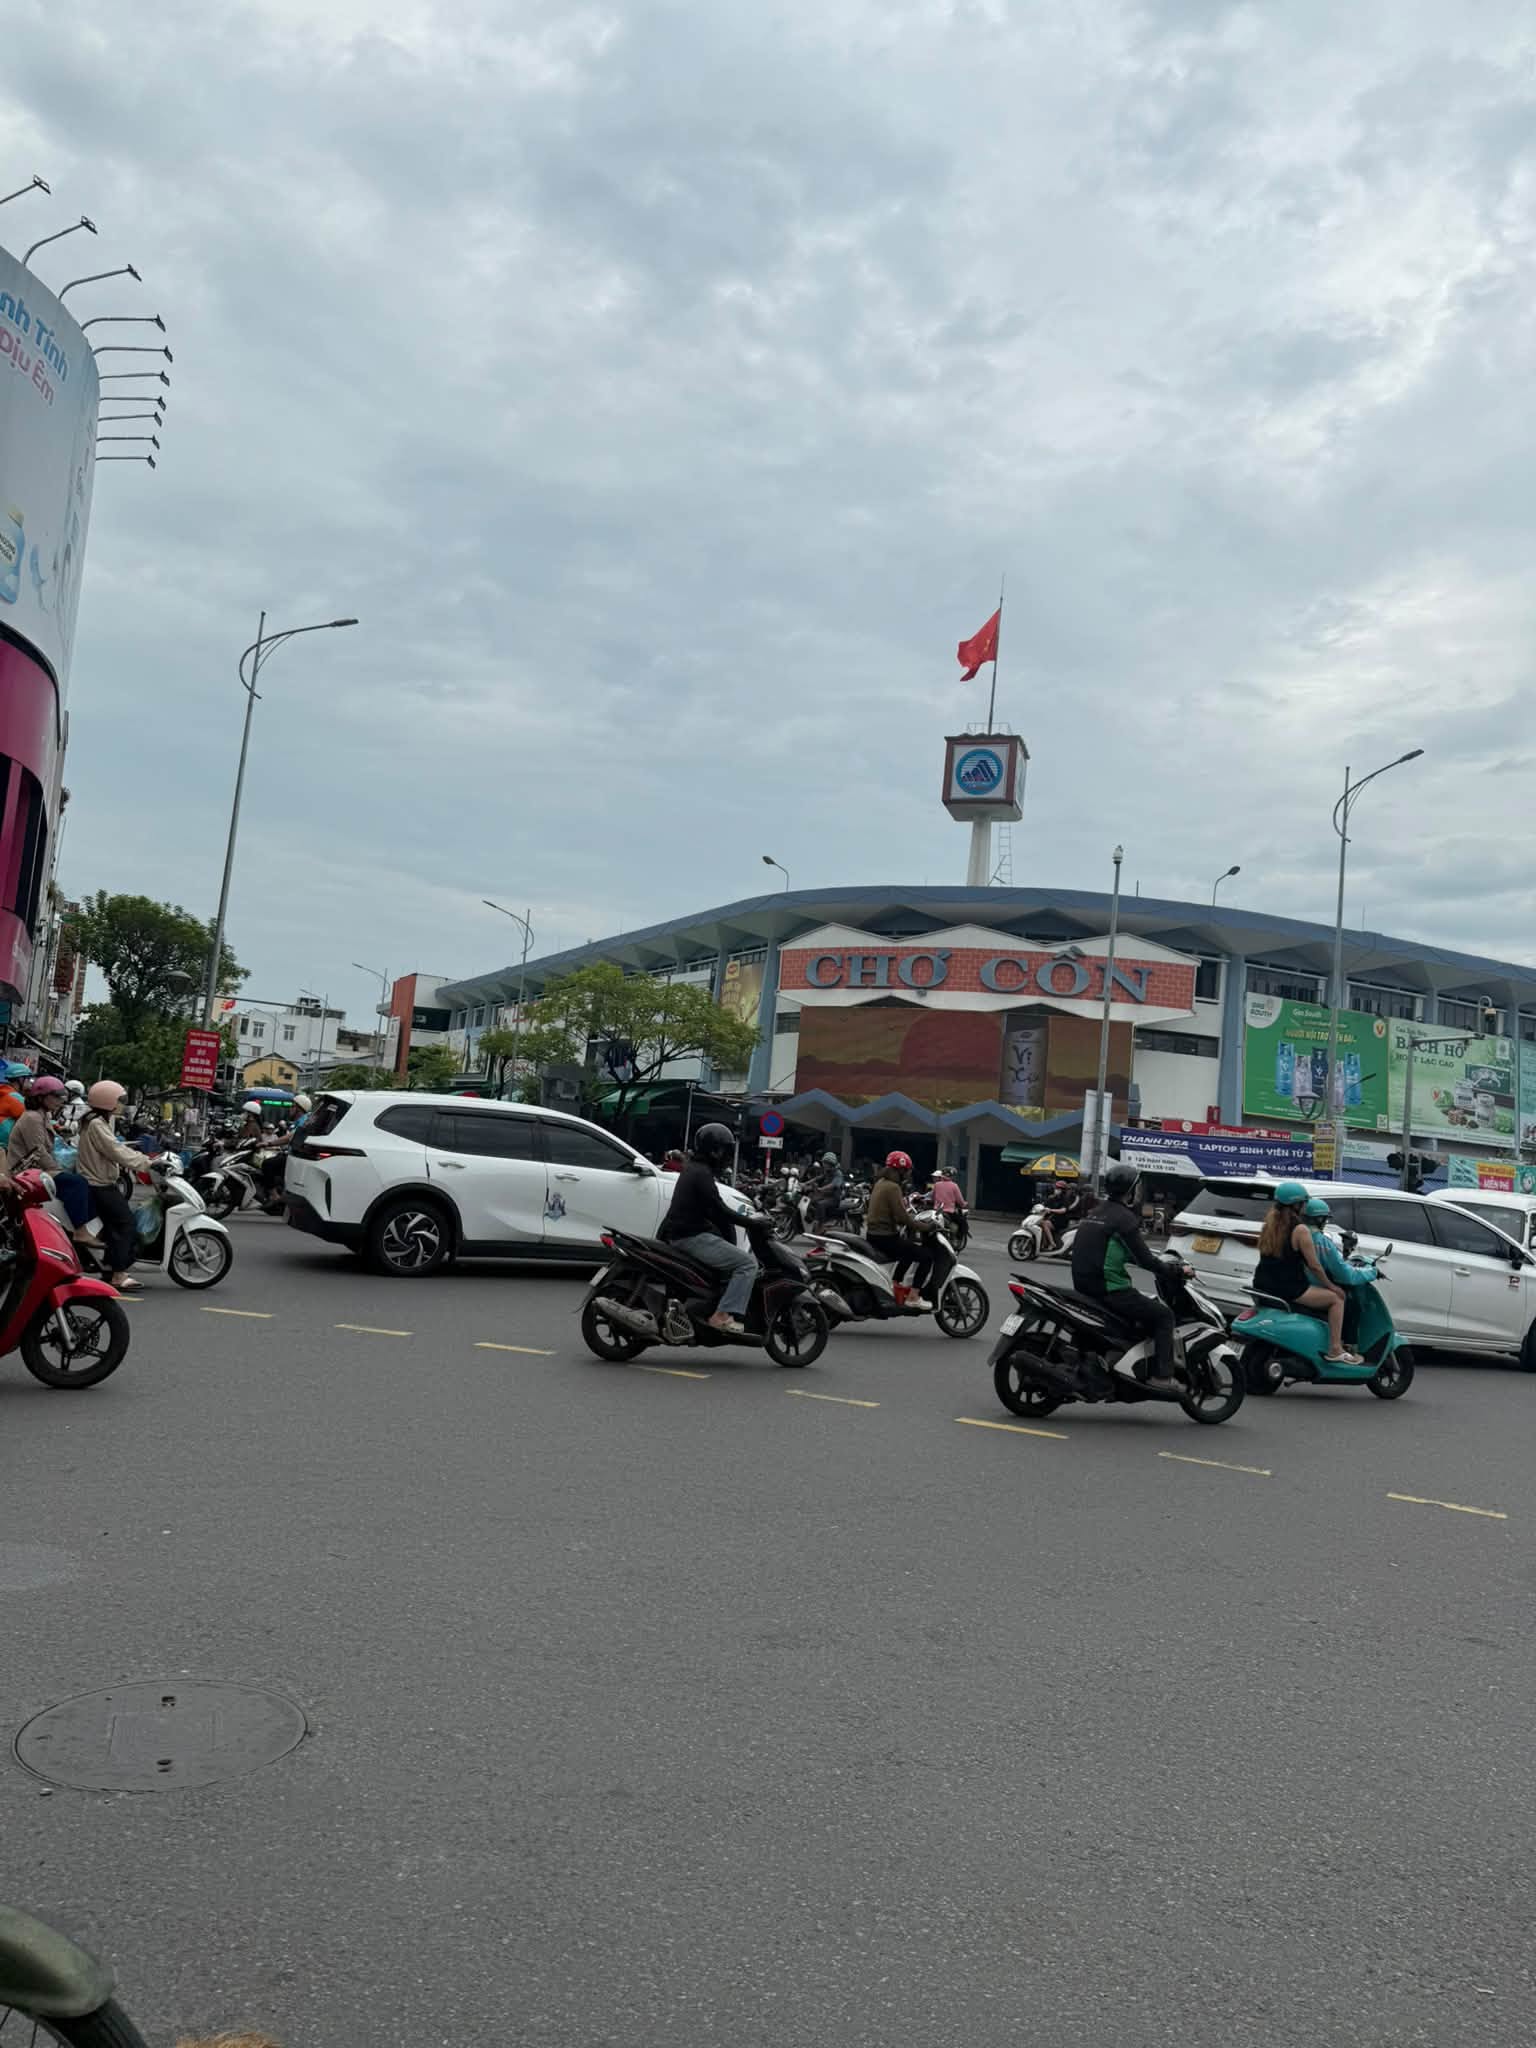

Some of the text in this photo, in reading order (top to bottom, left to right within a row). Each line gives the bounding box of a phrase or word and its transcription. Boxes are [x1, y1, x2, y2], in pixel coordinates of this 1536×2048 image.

[0, 326, 55, 407] Dịu Êm
[35, 317, 69, 382] Tính
[805, 947, 953, 997] CHỢ
[979, 944, 1152, 1003] CỒN
[1199, 1143, 1237, 1153] LAPTOP
[1239, 1147, 1263, 1155] SINH
[1266, 1147, 1289, 1157] VIÊN
